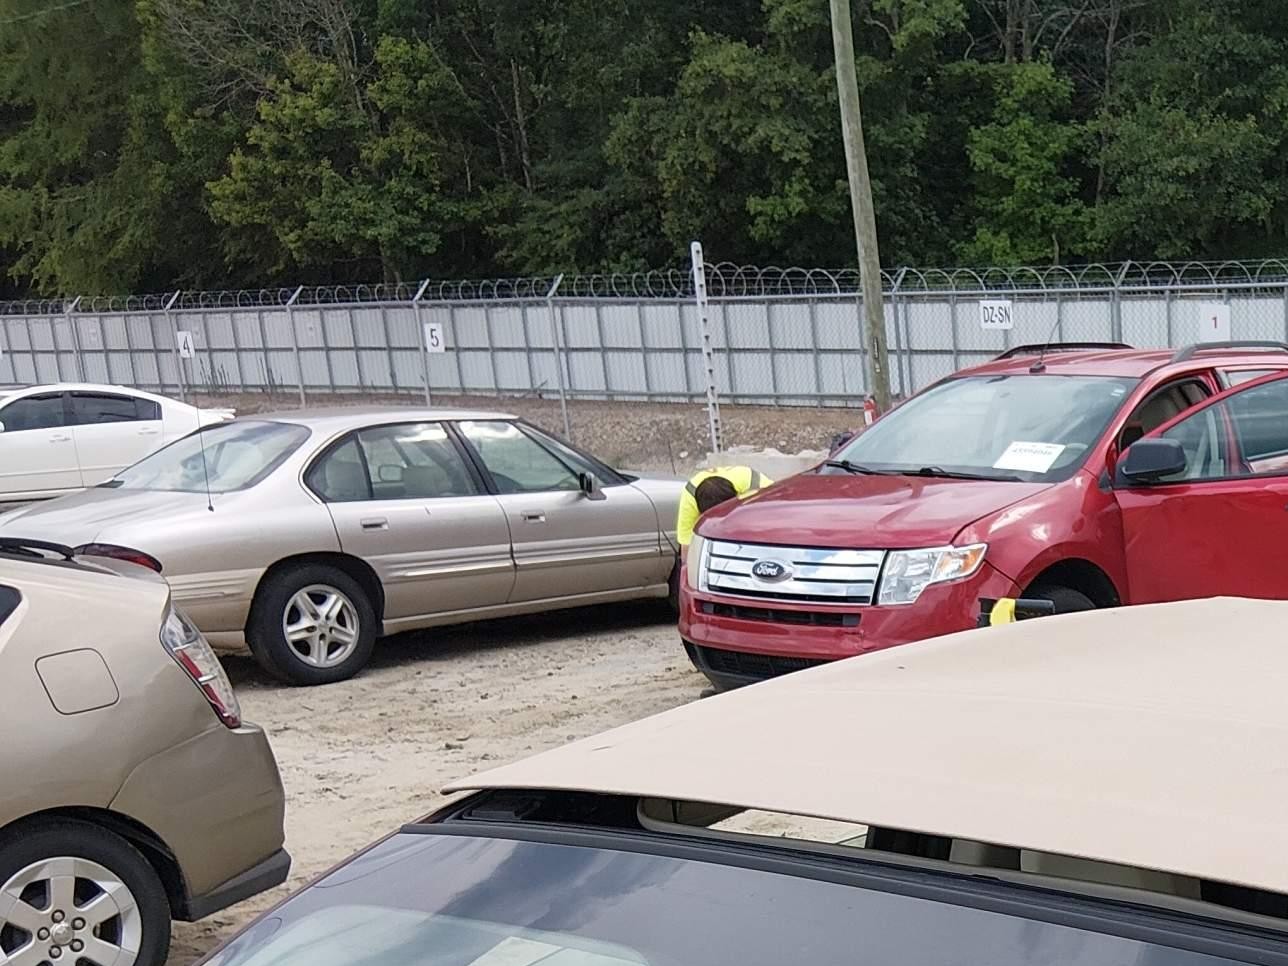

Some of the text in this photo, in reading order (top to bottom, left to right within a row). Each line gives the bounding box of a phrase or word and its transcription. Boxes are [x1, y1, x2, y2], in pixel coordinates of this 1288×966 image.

[982, 305, 1011, 324] DZ-SN
[1211, 316, 1217, 329] 1
[182, 335, 190, 354] 4
[430, 327, 440, 348] 5
